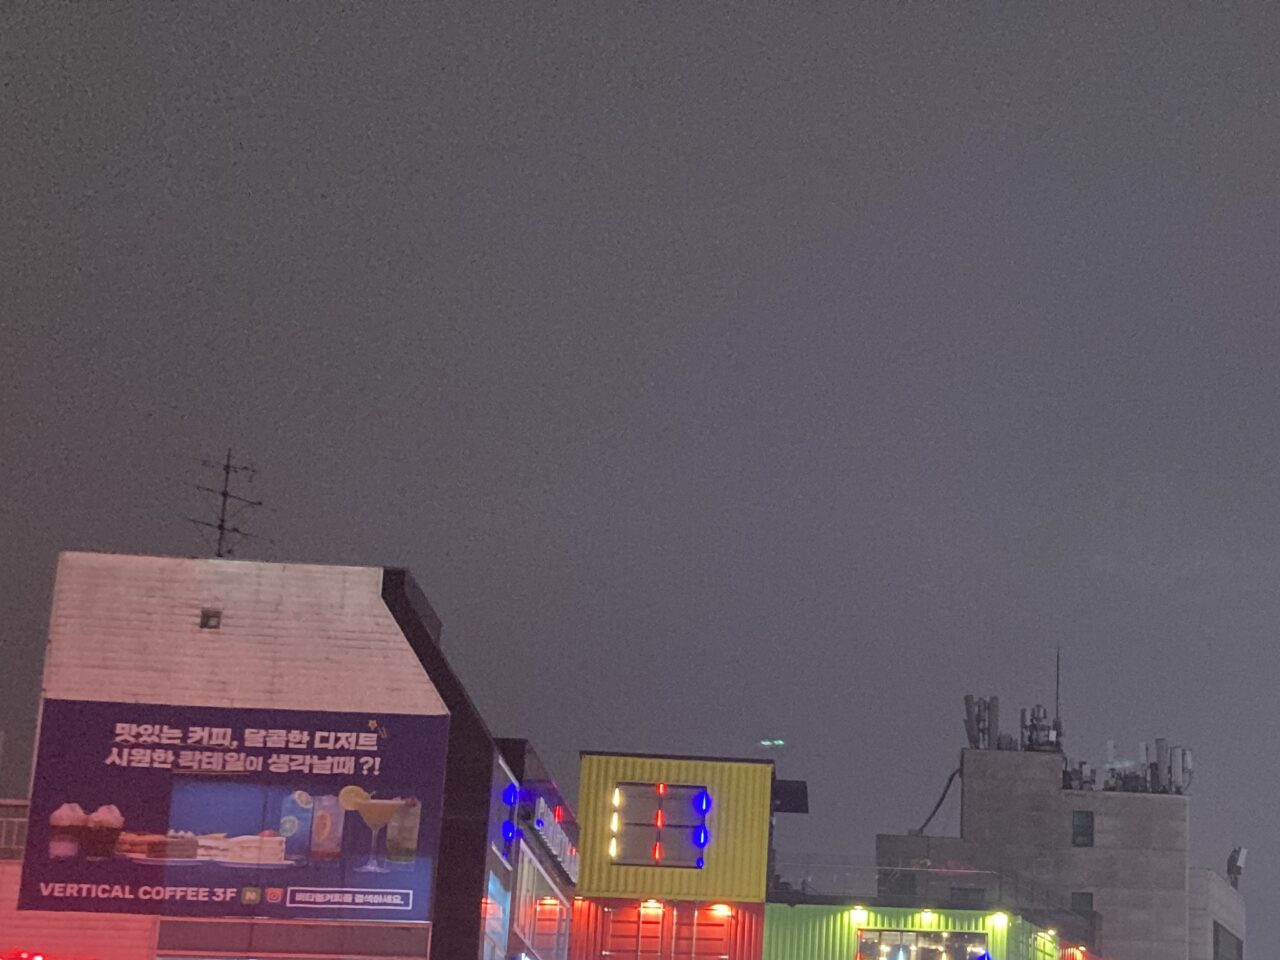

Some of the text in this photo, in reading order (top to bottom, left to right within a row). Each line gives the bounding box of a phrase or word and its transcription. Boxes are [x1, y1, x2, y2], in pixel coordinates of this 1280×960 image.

[115, 723, 378, 751] 맛있는 커피, 달콤한 디저트
[104, 747, 175, 769] 시원한
[267, 753, 355, 775] 생각날때
[39, 882, 238, 902] VERTICAL COFFEE 3F
